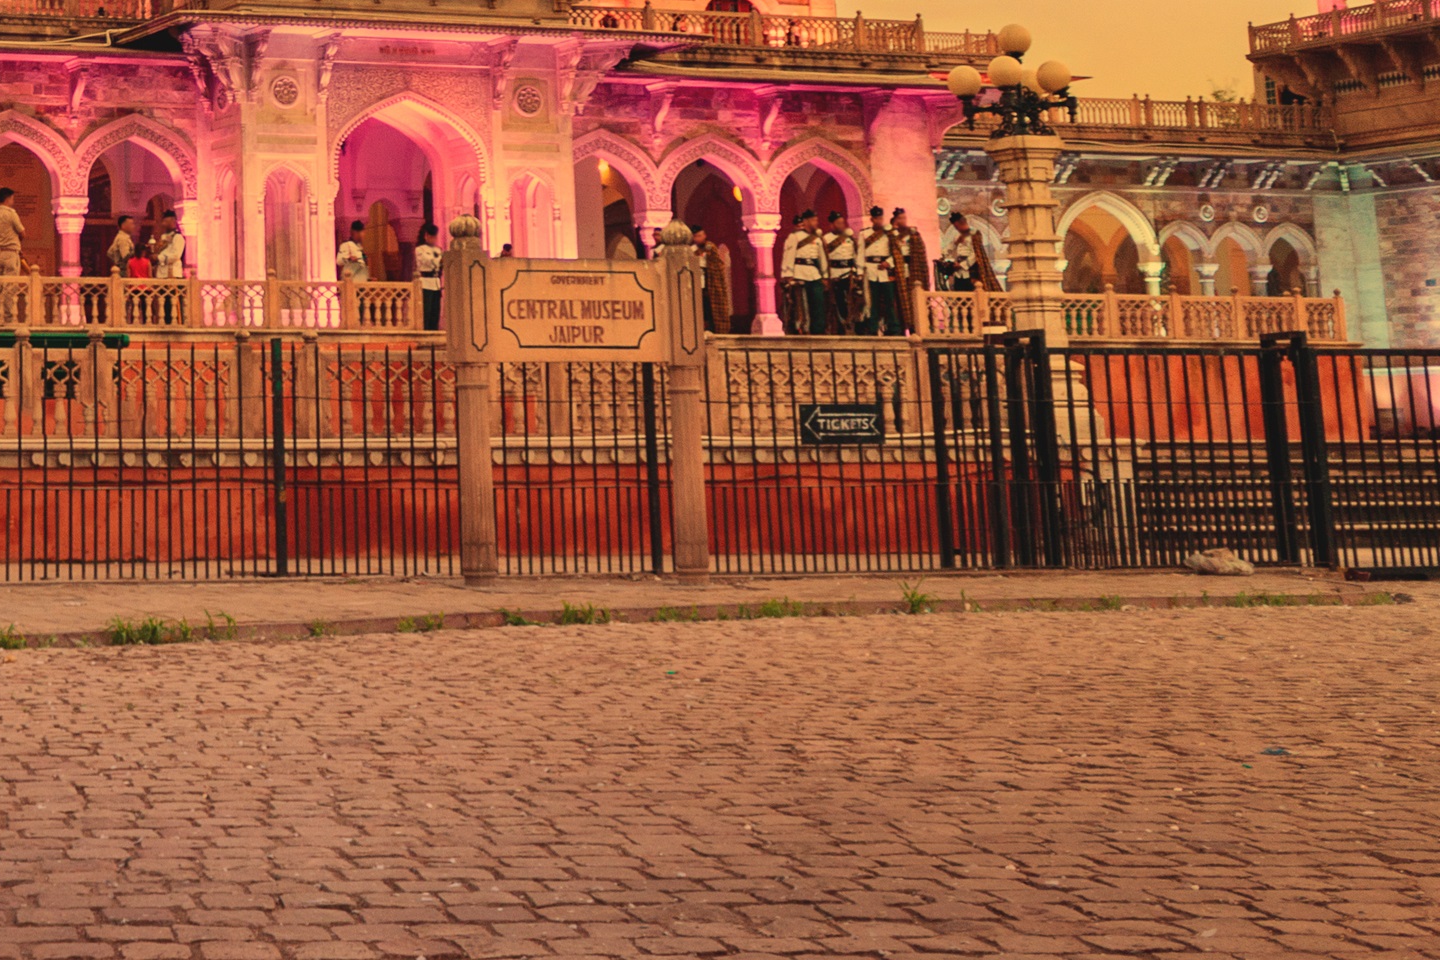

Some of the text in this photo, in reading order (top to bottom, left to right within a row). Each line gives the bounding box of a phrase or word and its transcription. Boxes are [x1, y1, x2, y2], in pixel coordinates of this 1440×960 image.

[550, 275, 605, 286] GOVERNMENT
[507, 298, 645, 320] CENTRAL MUSEUM
[549, 325, 604, 344] JAIPUR
[816, 417, 870, 431] TICKETS
